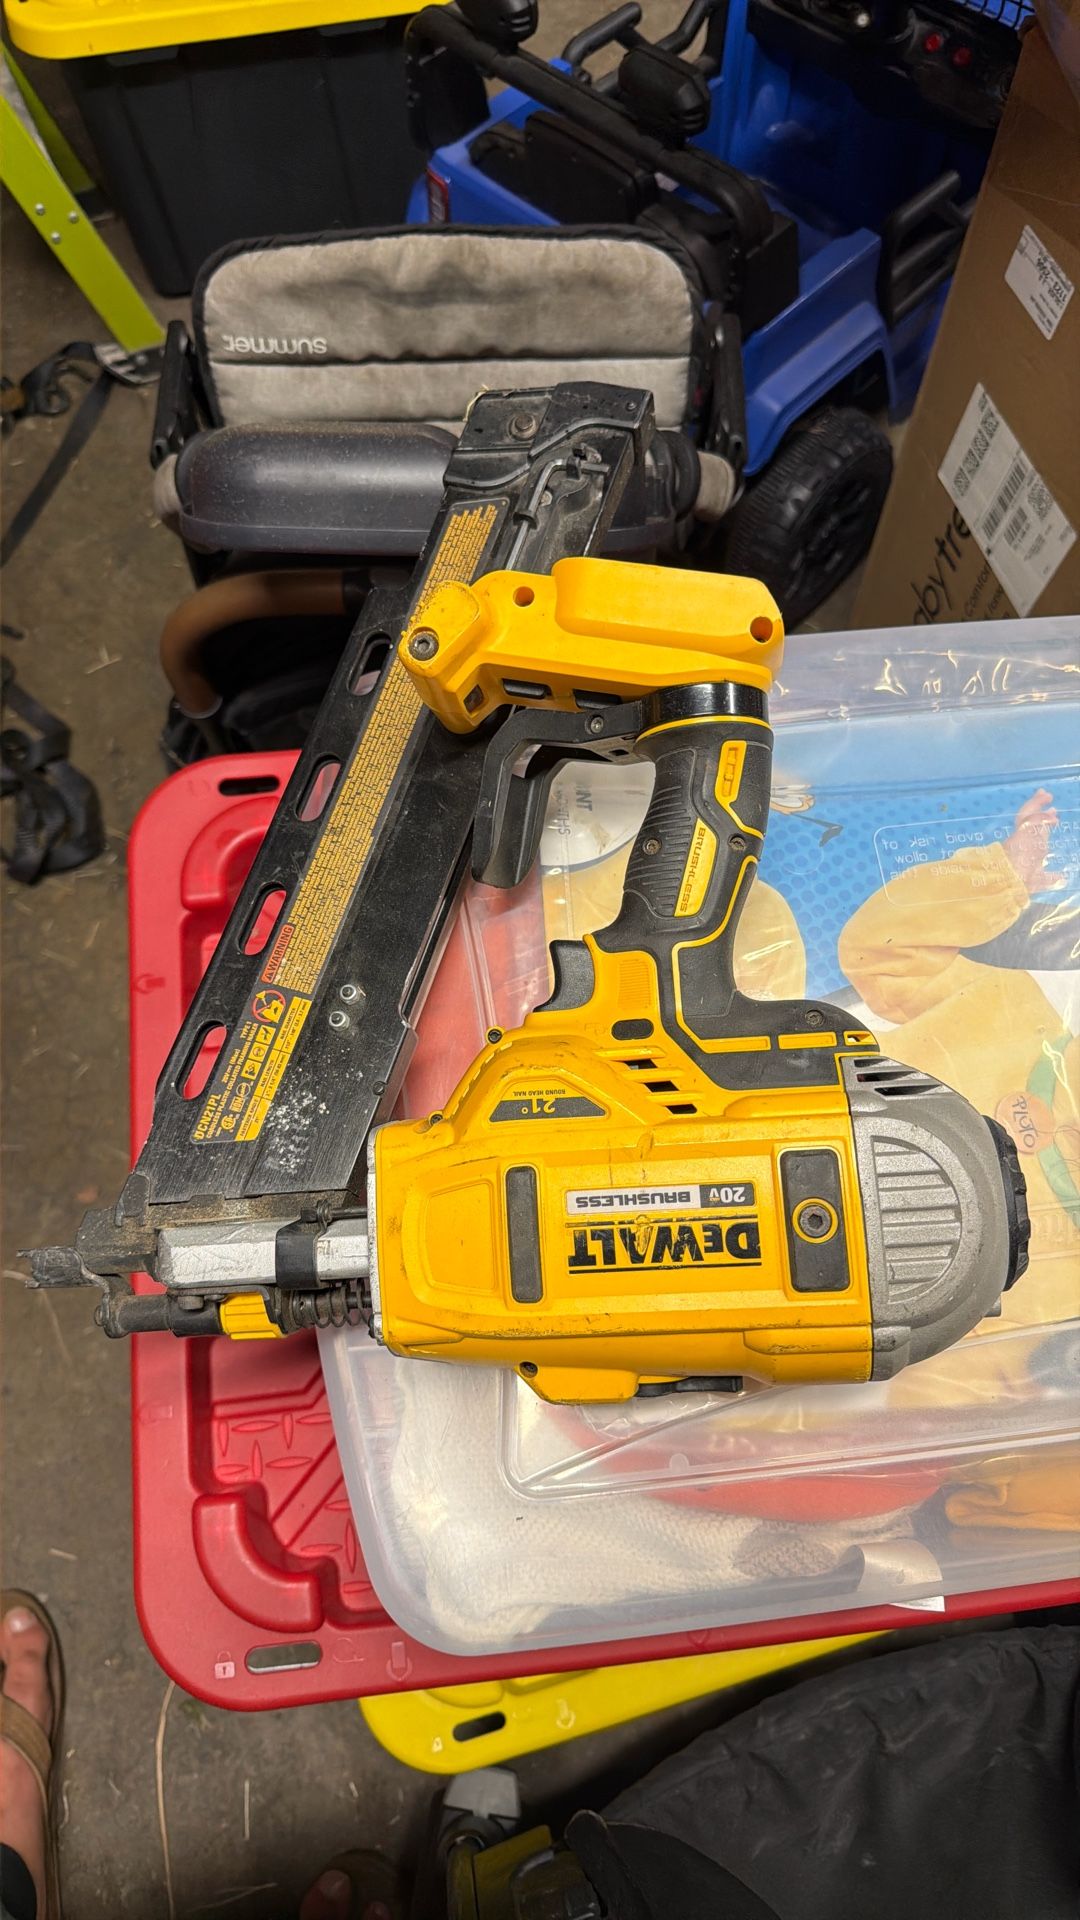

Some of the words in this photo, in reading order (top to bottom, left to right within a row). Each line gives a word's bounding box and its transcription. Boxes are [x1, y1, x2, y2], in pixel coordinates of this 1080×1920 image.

[680, 827, 706, 912] BRUSHLESS
[267, 926, 292, 971] WARNING
[521, 1098, 556, 1114] 21°
[1011, 1096, 1039, 1148] PLUTO
[576, 1191, 691, 1208] BRUSHLESS
[568, 1222, 762, 1267] DEWALT
